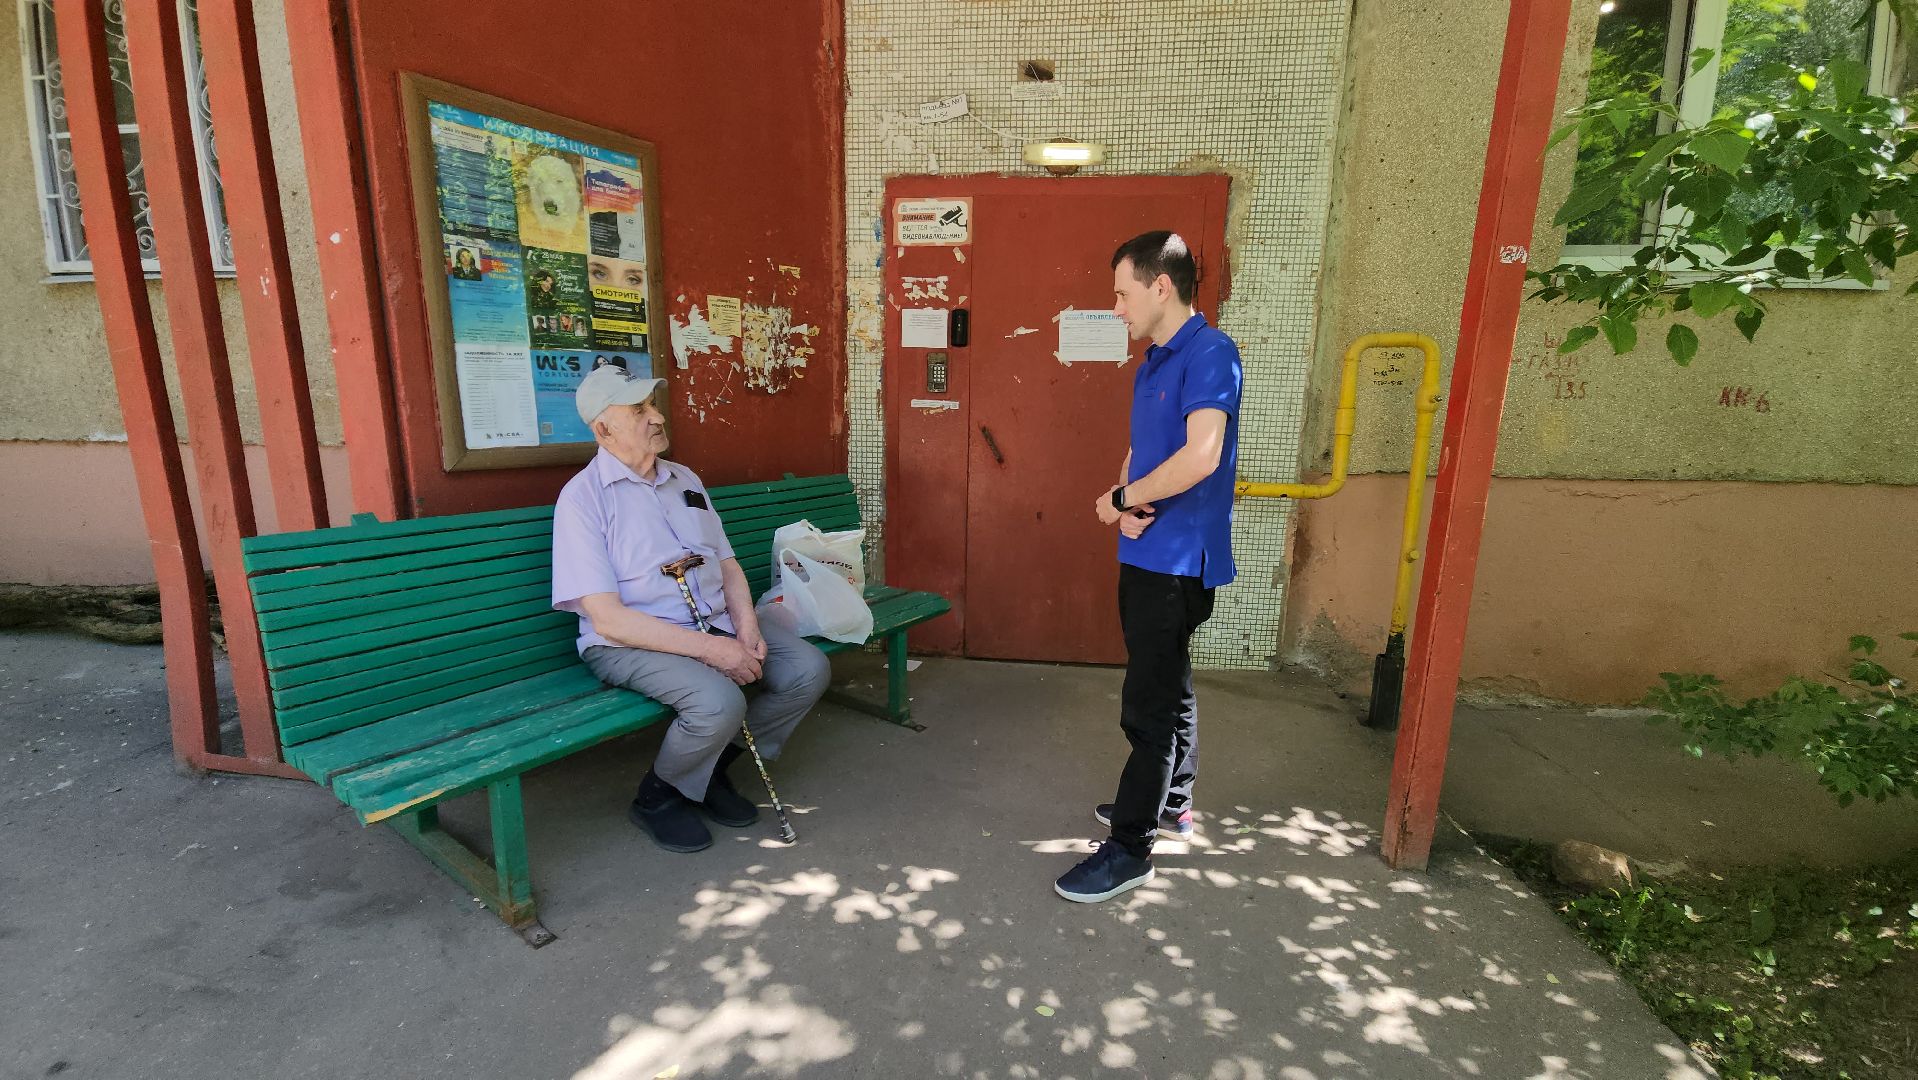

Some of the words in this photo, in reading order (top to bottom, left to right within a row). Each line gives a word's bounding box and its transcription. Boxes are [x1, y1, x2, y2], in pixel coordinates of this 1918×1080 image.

[479, 115, 600, 158] ИНФОРМАЦИЯ
[902, 214, 935, 222] ВНИМАНИЕ
[595, 288, 640, 300] СМОТРИТЕ
[536, 355, 581, 372] WKS
